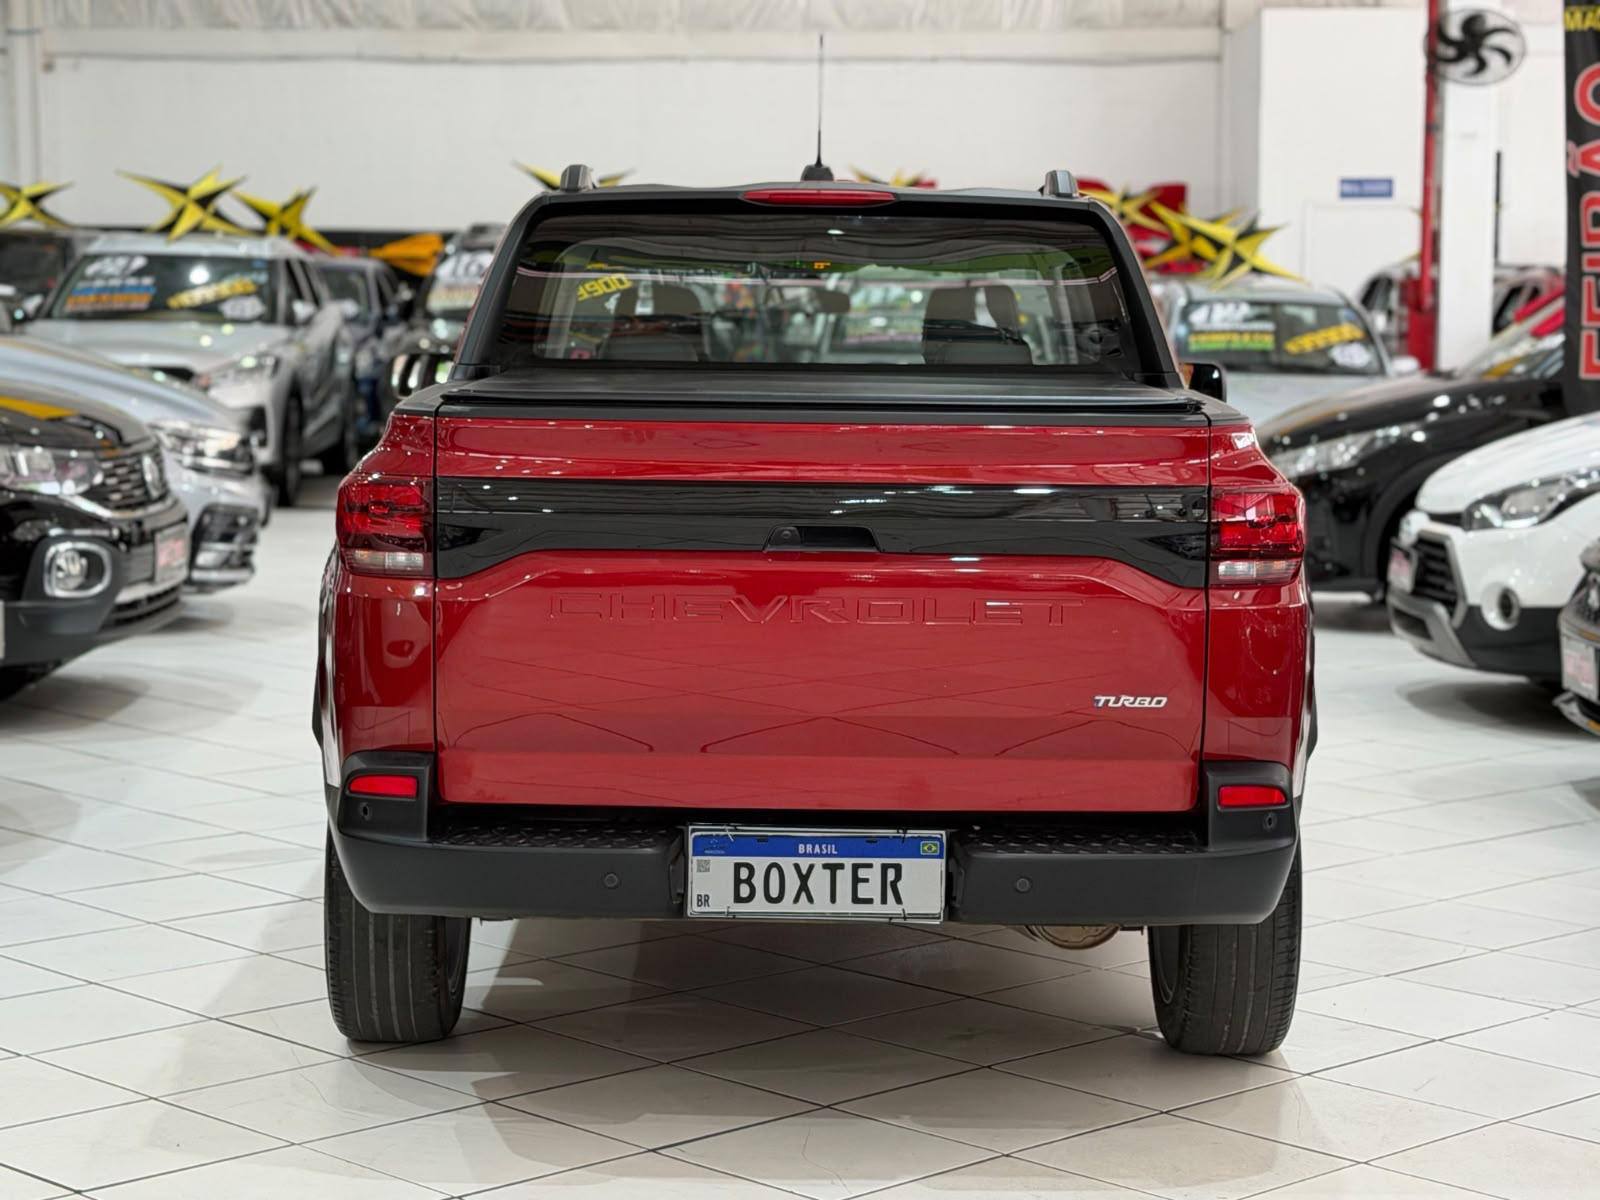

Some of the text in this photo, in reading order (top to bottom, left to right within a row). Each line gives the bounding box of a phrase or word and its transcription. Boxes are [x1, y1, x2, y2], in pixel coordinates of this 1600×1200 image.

[550, 592, 1085, 626] CHEVROLET
[1093, 694, 1168, 708] TURBO
[798, 843, 838, 855] BRASIL
[733, 862, 904, 905] BOXTER
[696, 893, 710, 907] BR
